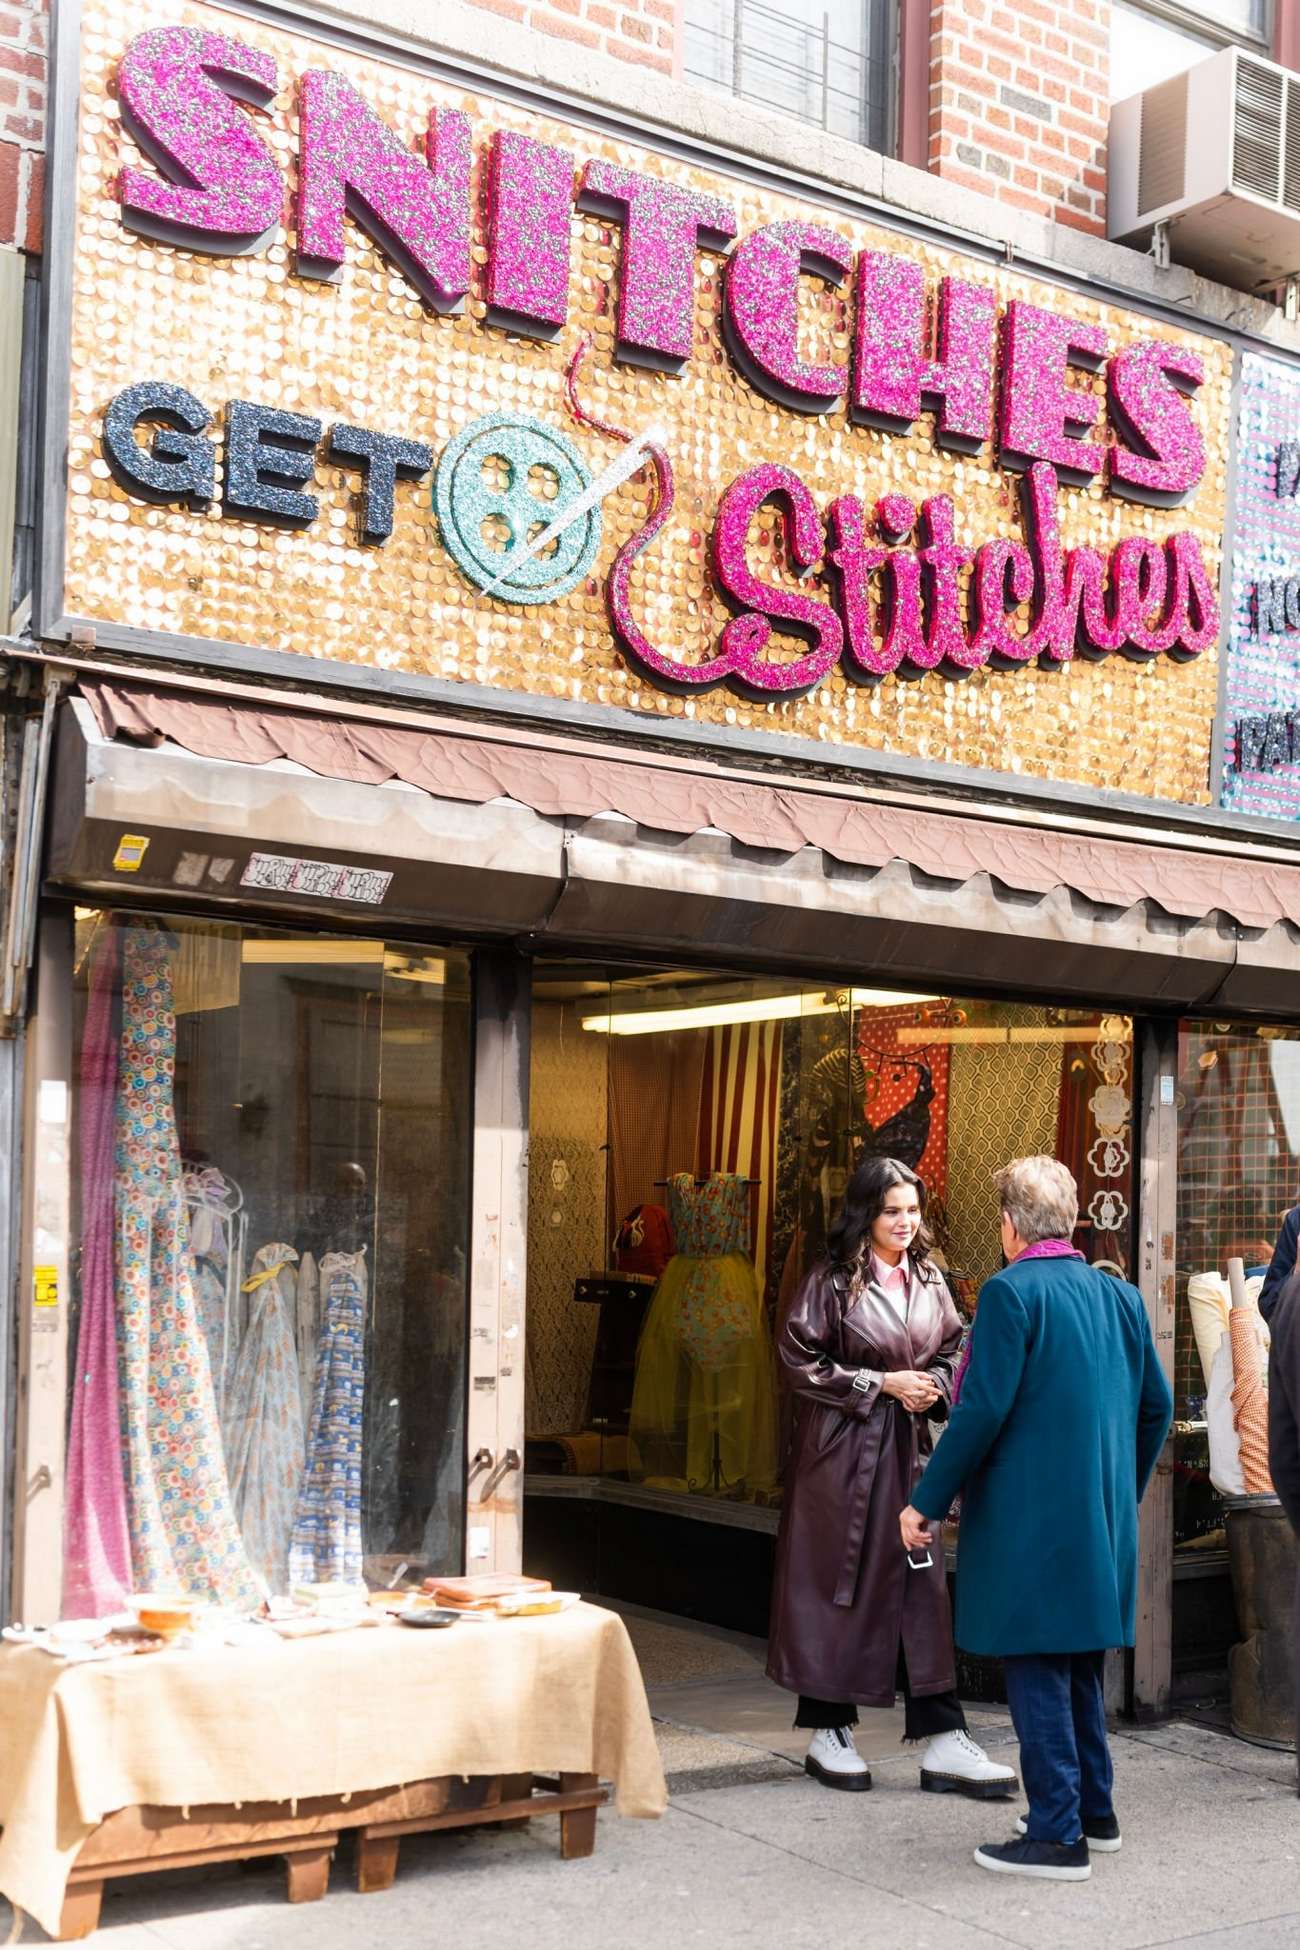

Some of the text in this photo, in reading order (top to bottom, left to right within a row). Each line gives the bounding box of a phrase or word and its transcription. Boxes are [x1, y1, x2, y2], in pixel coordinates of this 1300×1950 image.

[117, 26, 1206, 506] SNITCHES
[103, 380, 1221, 695] GET Stitches
